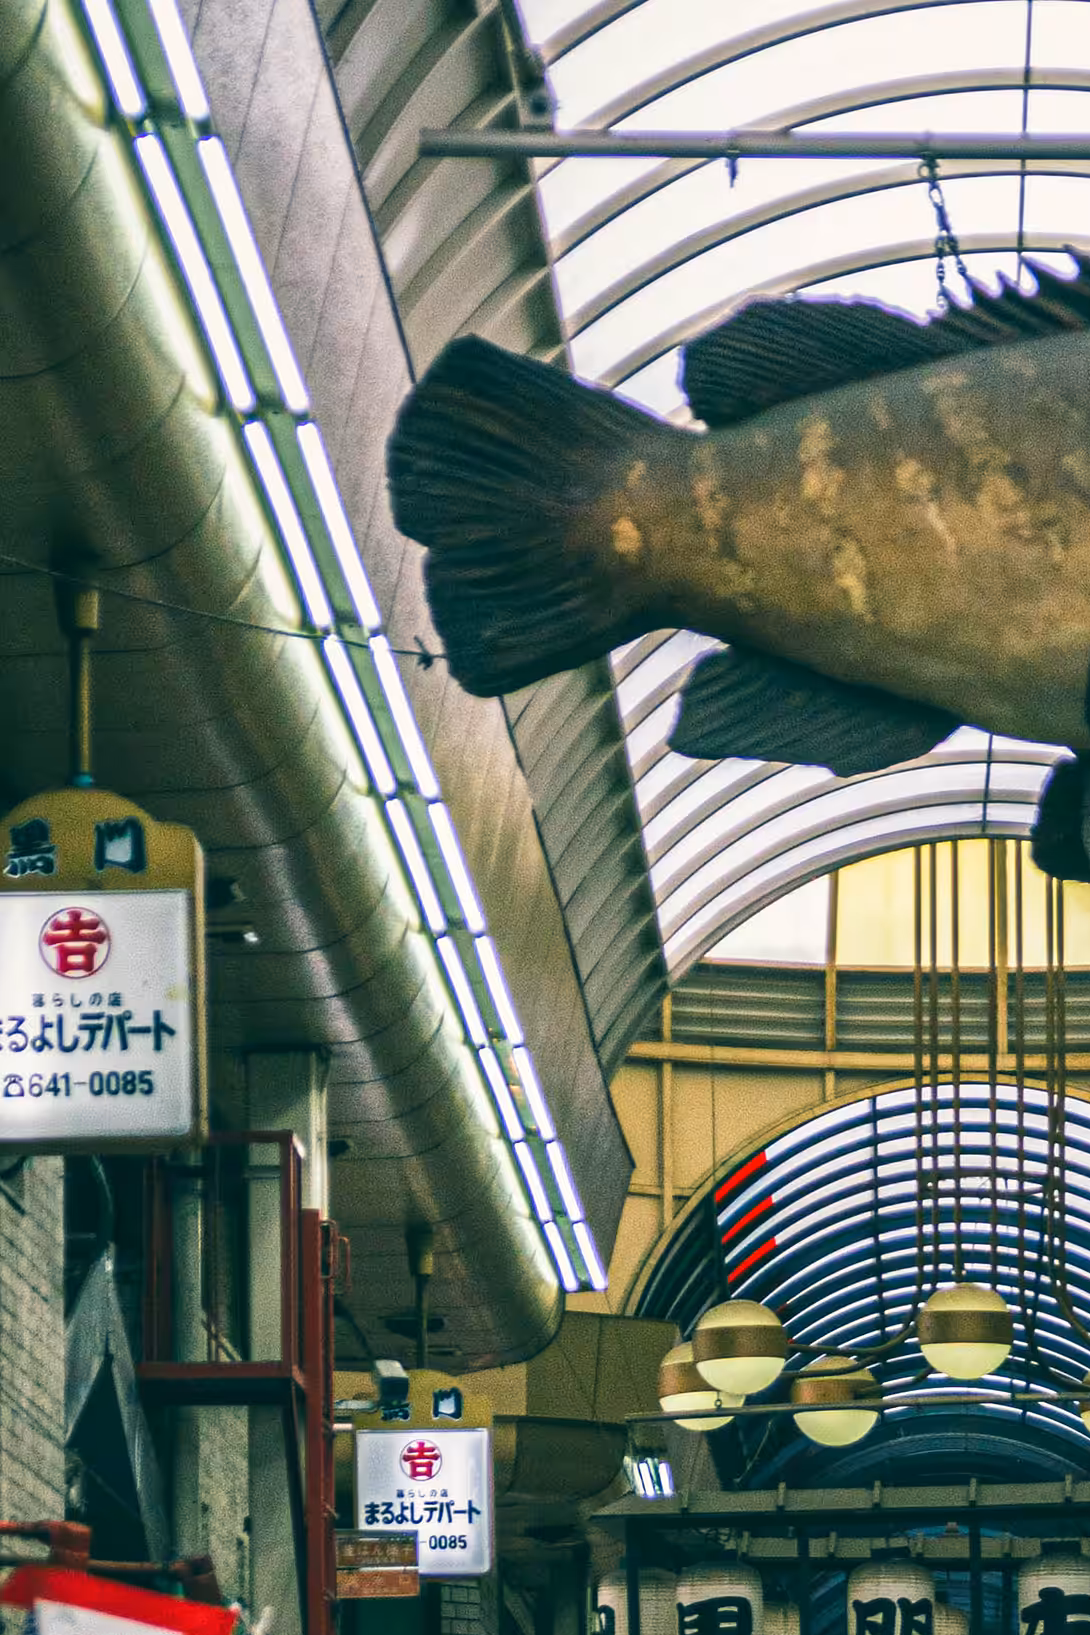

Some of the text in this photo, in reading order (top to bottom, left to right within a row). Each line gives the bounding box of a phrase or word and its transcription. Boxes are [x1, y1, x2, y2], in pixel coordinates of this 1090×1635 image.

[3, 817, 147, 878] 黒門
[32, 993, 123, 1008] 暮らしの店
[0, 1010, 176, 1053] るよしデパート
[28, 1070, 154, 1098] 641-0085
[364, 1499, 481, 1526] まるよしデパート
[418, 1534, 468, 1550] -0085
